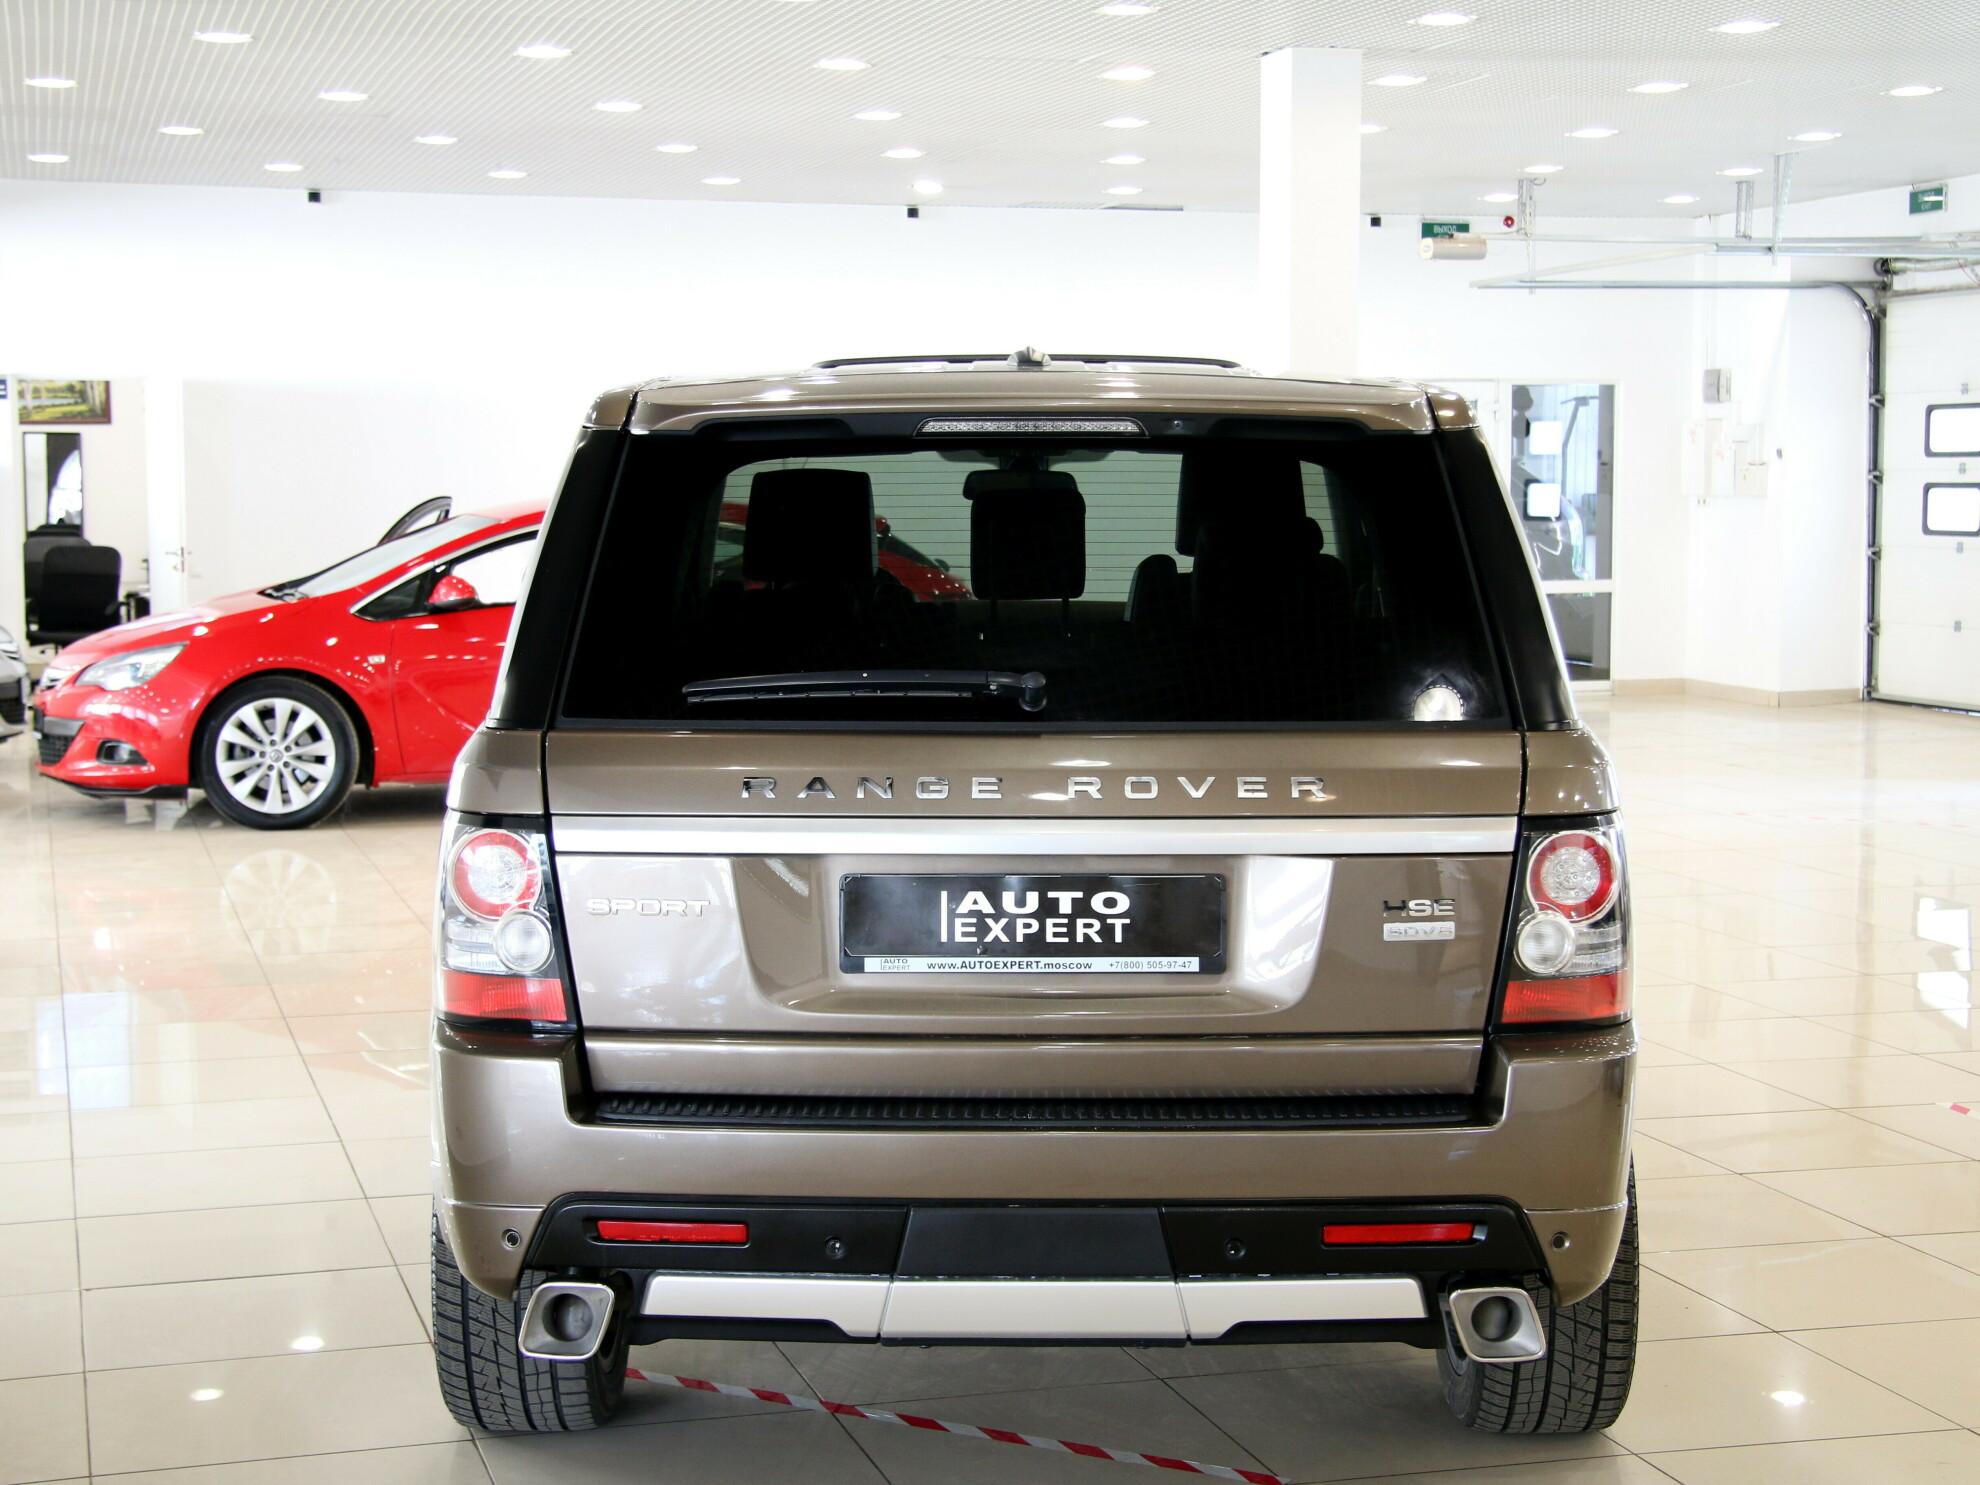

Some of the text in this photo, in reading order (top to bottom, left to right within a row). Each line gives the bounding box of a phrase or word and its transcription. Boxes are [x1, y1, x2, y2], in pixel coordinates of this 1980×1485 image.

[741, 776, 1326, 799] RANGE ROVER
[586, 898, 710, 917] SPORT
[955, 890, 1130, 915] AUTO
[1383, 899, 1455, 917] HSE
[954, 917, 1131, 943] EXPERT
[926, 960, 1192, 970] www.AUTOEXPERT.moscow +7(800) 505-97-47
